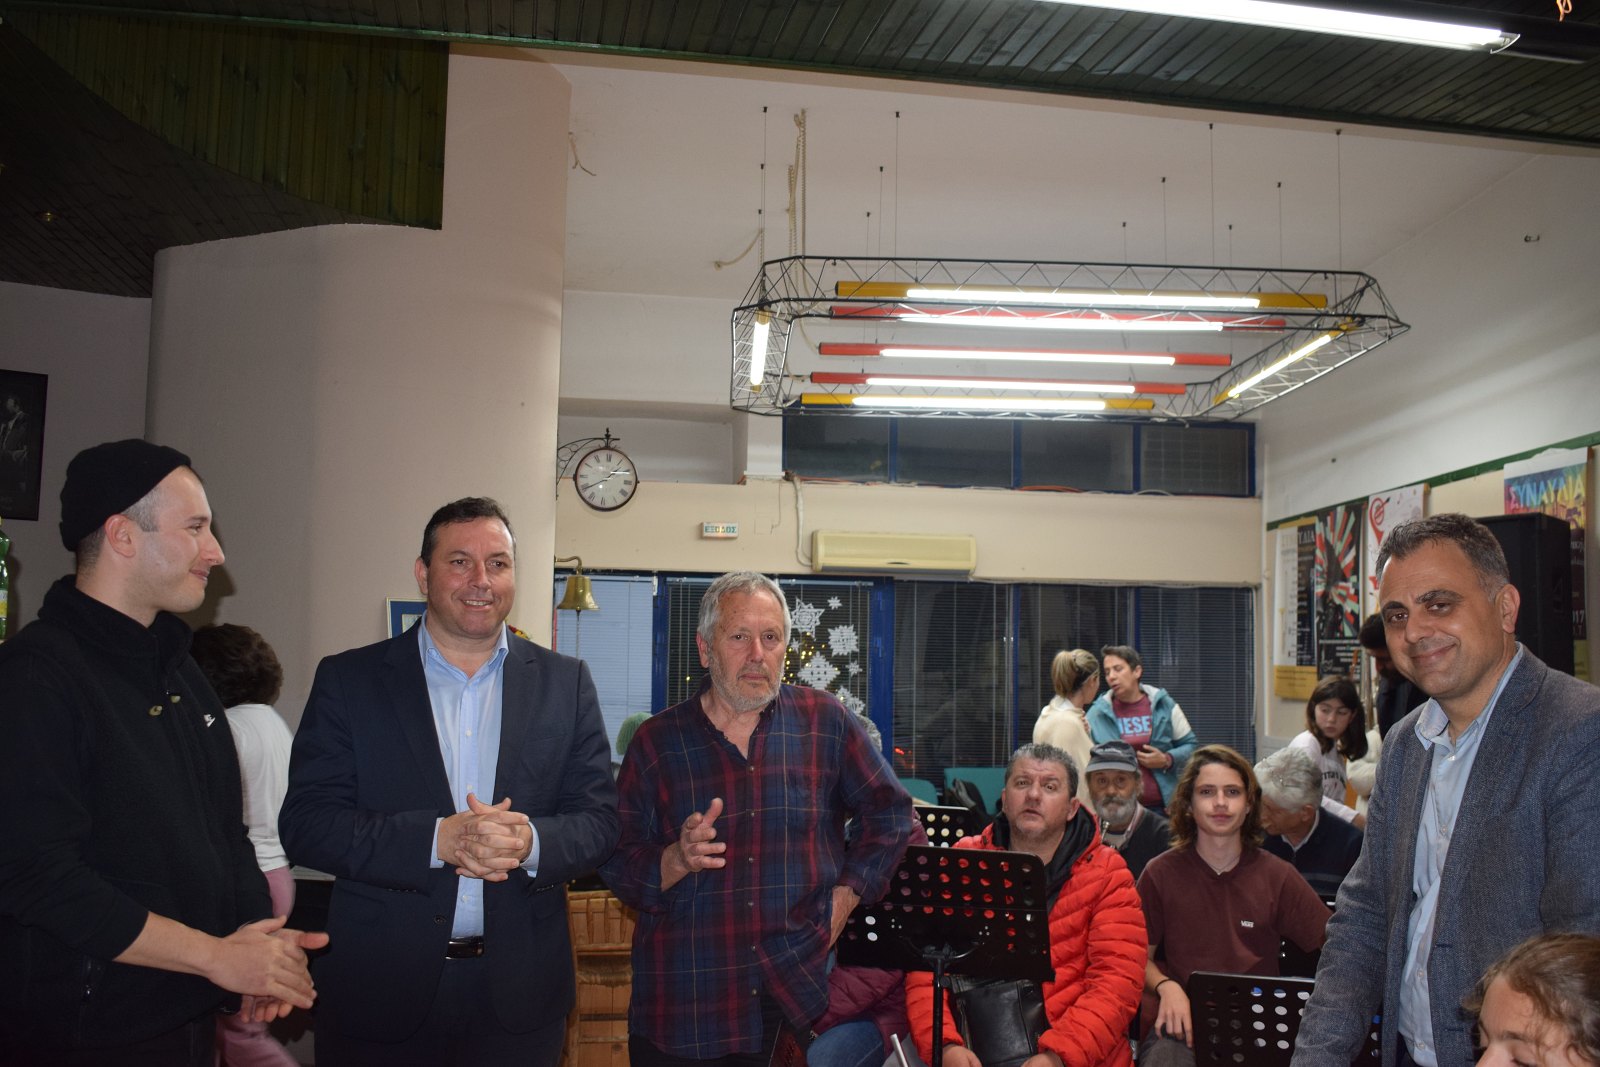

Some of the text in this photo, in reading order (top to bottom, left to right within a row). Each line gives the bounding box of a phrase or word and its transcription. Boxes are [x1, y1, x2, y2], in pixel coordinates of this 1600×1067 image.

[1509, 475, 1585, 510] ΣΥΝΑΥΛΙΑ
[704, 525, 737, 534] ΕΞΟΔΟΣ
[1117, 715, 1151, 735] IESE
